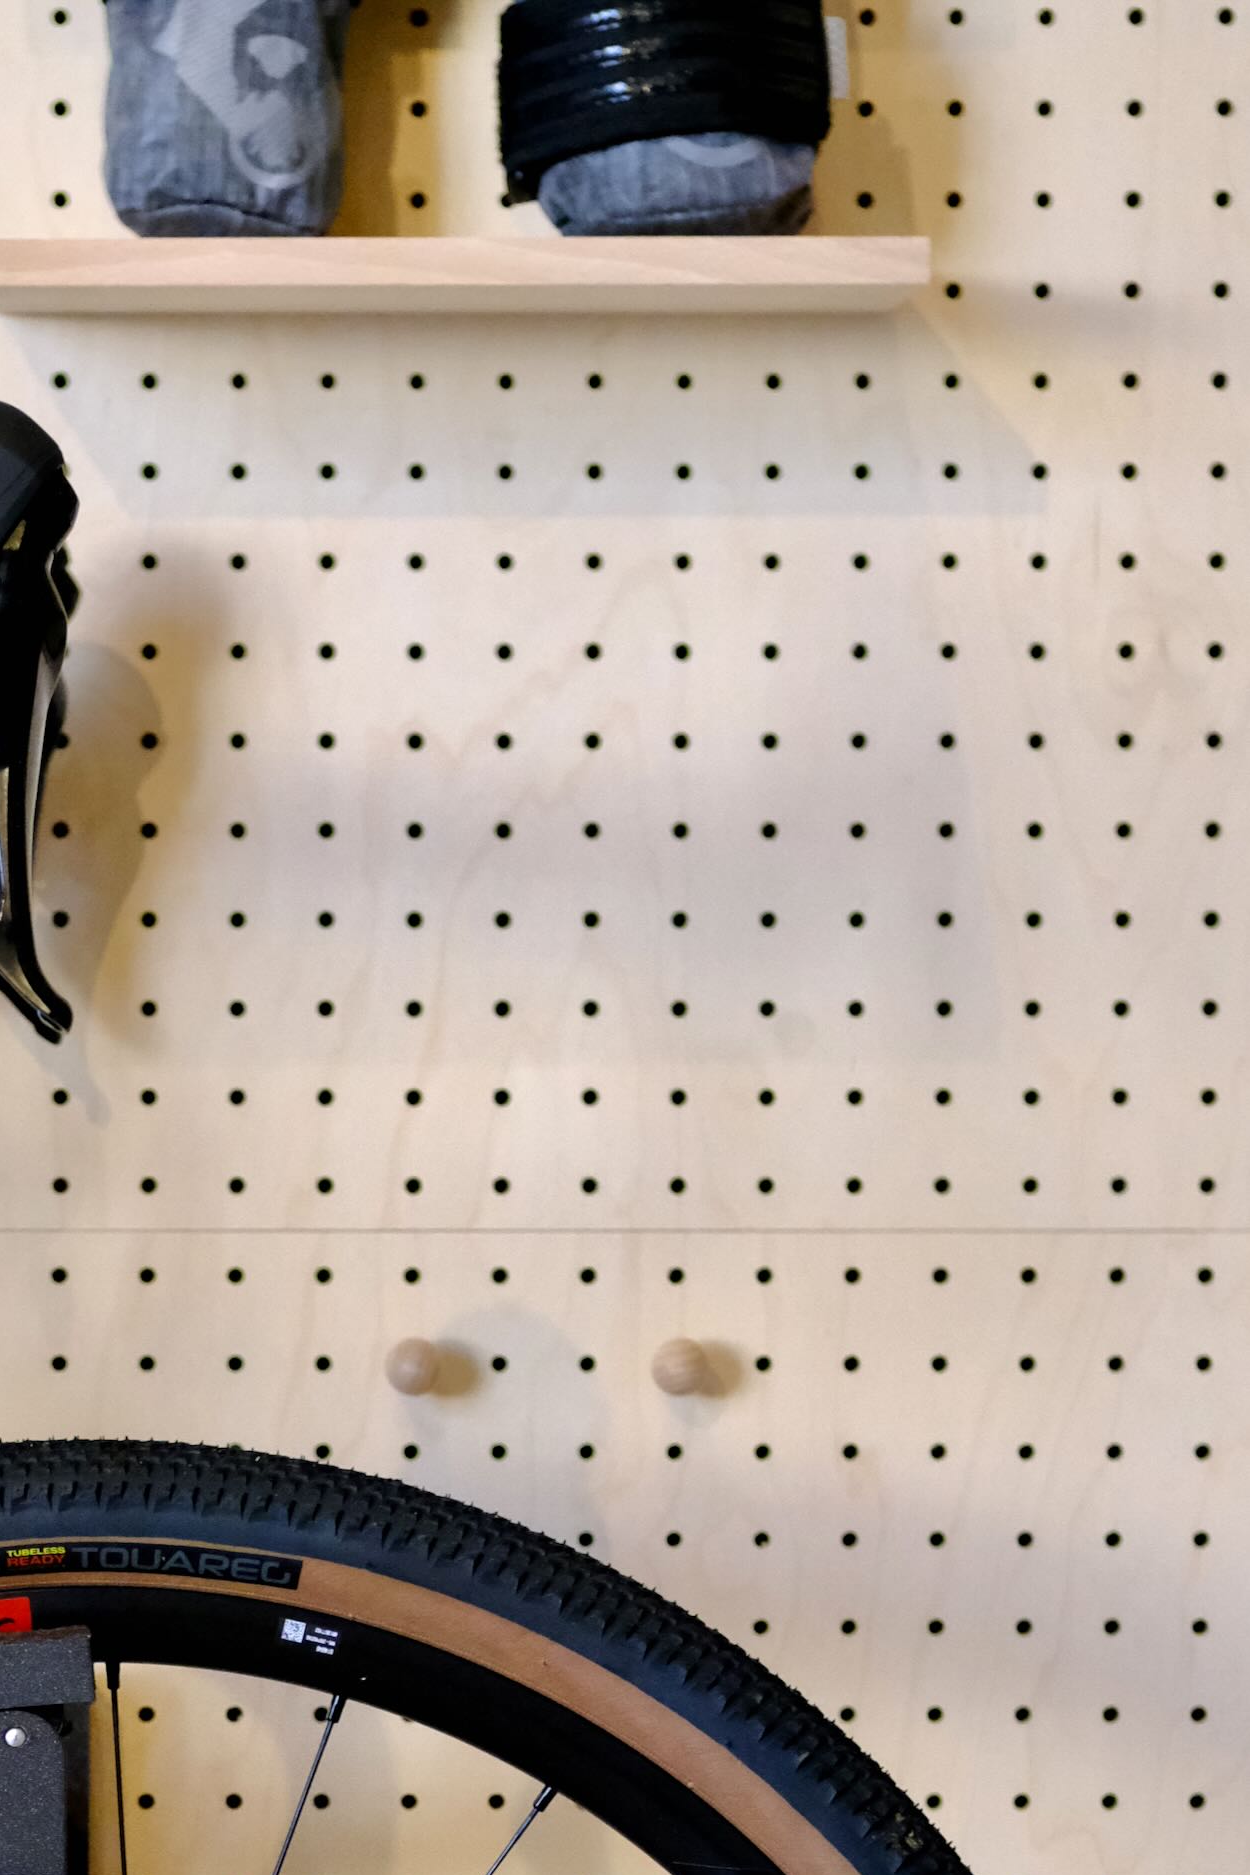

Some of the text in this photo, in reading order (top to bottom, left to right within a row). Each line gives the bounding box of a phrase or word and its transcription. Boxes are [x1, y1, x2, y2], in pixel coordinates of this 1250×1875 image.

[7, 1546, 66, 1557] TUBELESS
[7, 1555, 64, 1567] READY
[69, 1546, 292, 1585] TOUAREG
